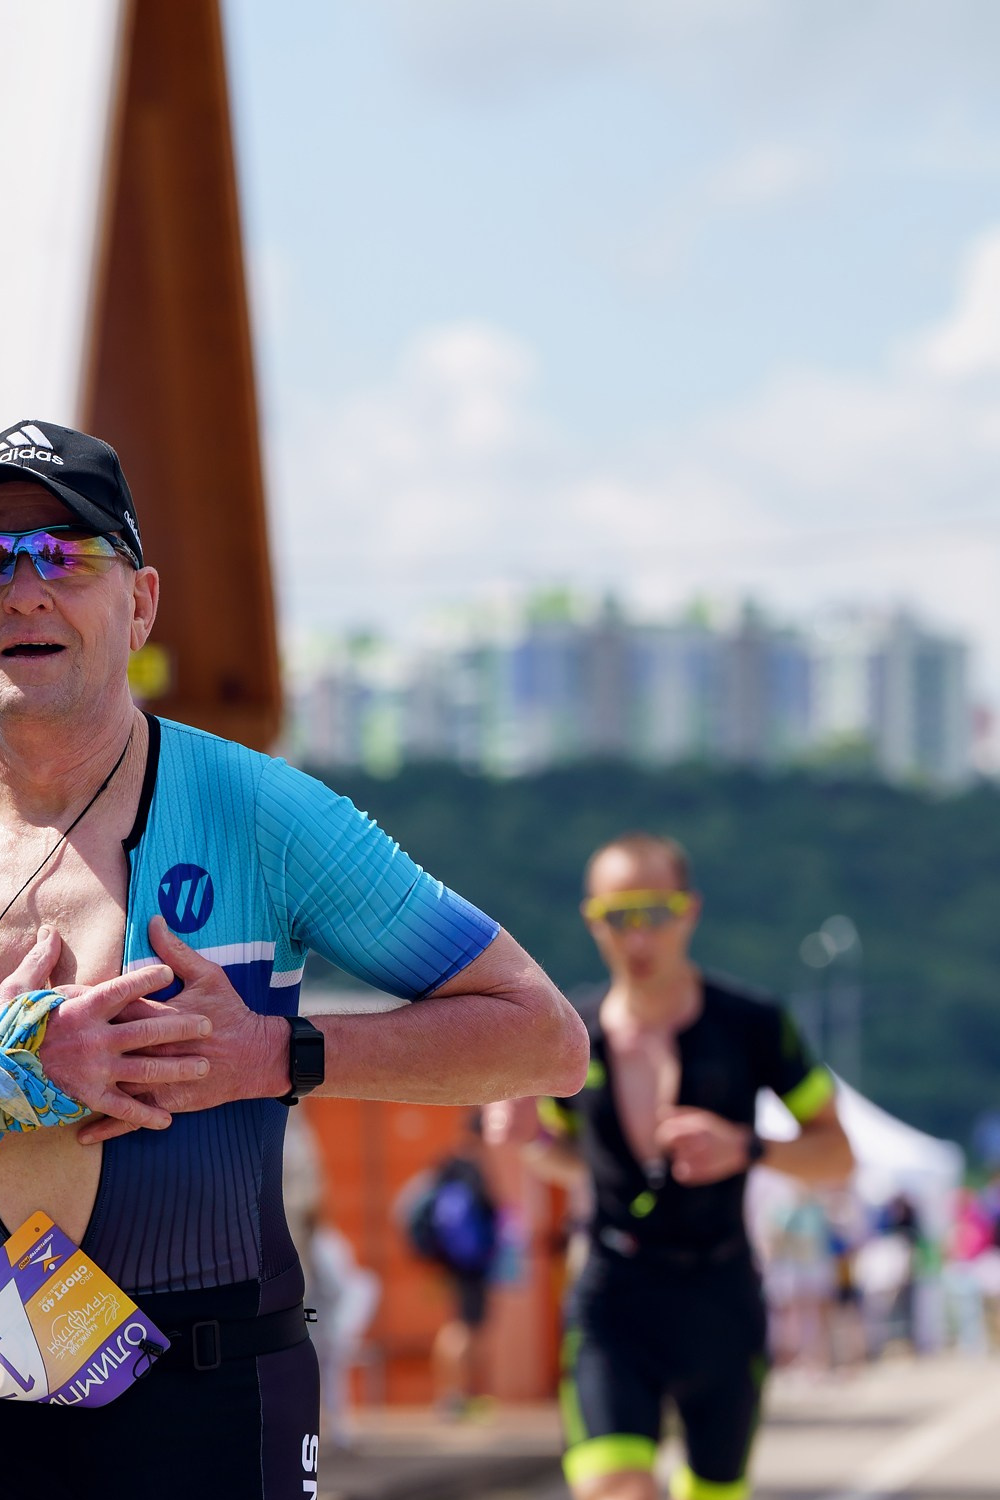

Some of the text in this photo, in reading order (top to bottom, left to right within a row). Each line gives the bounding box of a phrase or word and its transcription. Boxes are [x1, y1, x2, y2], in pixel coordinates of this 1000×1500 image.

[54, 1265, 88, 1301] СПОРТ
[79, 1271, 94, 1285] PRO
[41, 1297, 55, 1313] 40
